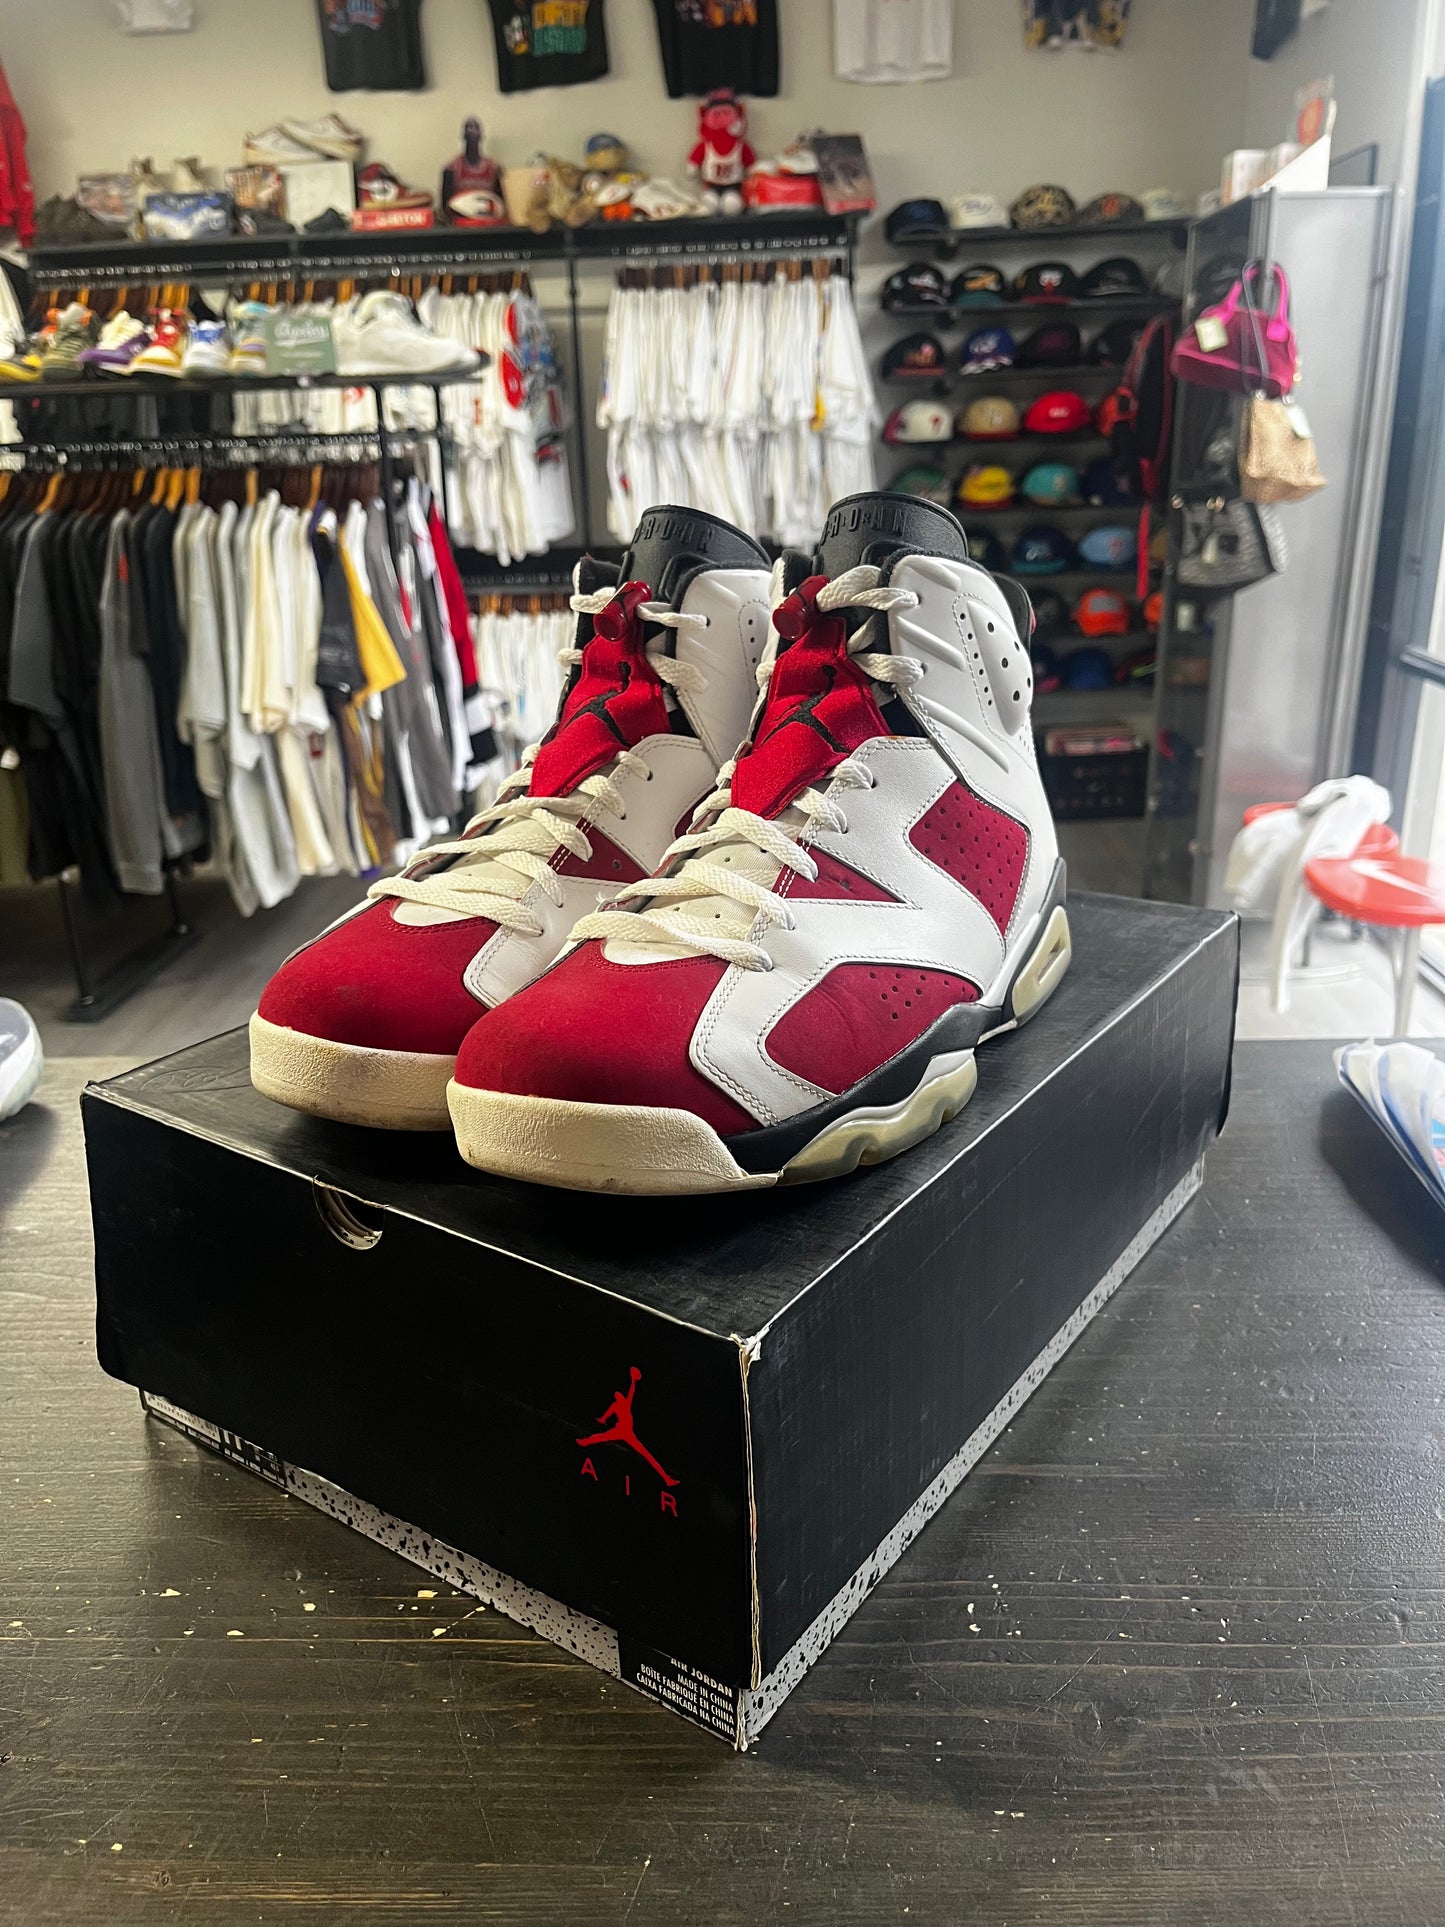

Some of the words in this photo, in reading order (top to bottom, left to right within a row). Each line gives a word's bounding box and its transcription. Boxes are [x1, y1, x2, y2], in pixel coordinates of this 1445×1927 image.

[581, 1457, 678, 1517] AIR
[677, 1673, 699, 1693] MADE
[699, 1686, 709, 1699] IN
[710, 1692, 734, 1714] CHINA
[691, 1667, 733, 1698] JORDAN
[636, 1672, 658, 1691] CAIXA
[658, 1684, 698, 1715] FABRICADA
[700, 1708, 710, 1722] NA
[711, 1716, 736, 1737] CHINA
[699, 1697, 709, 1710] EN
[711, 1704, 735, 1726] CHINA
